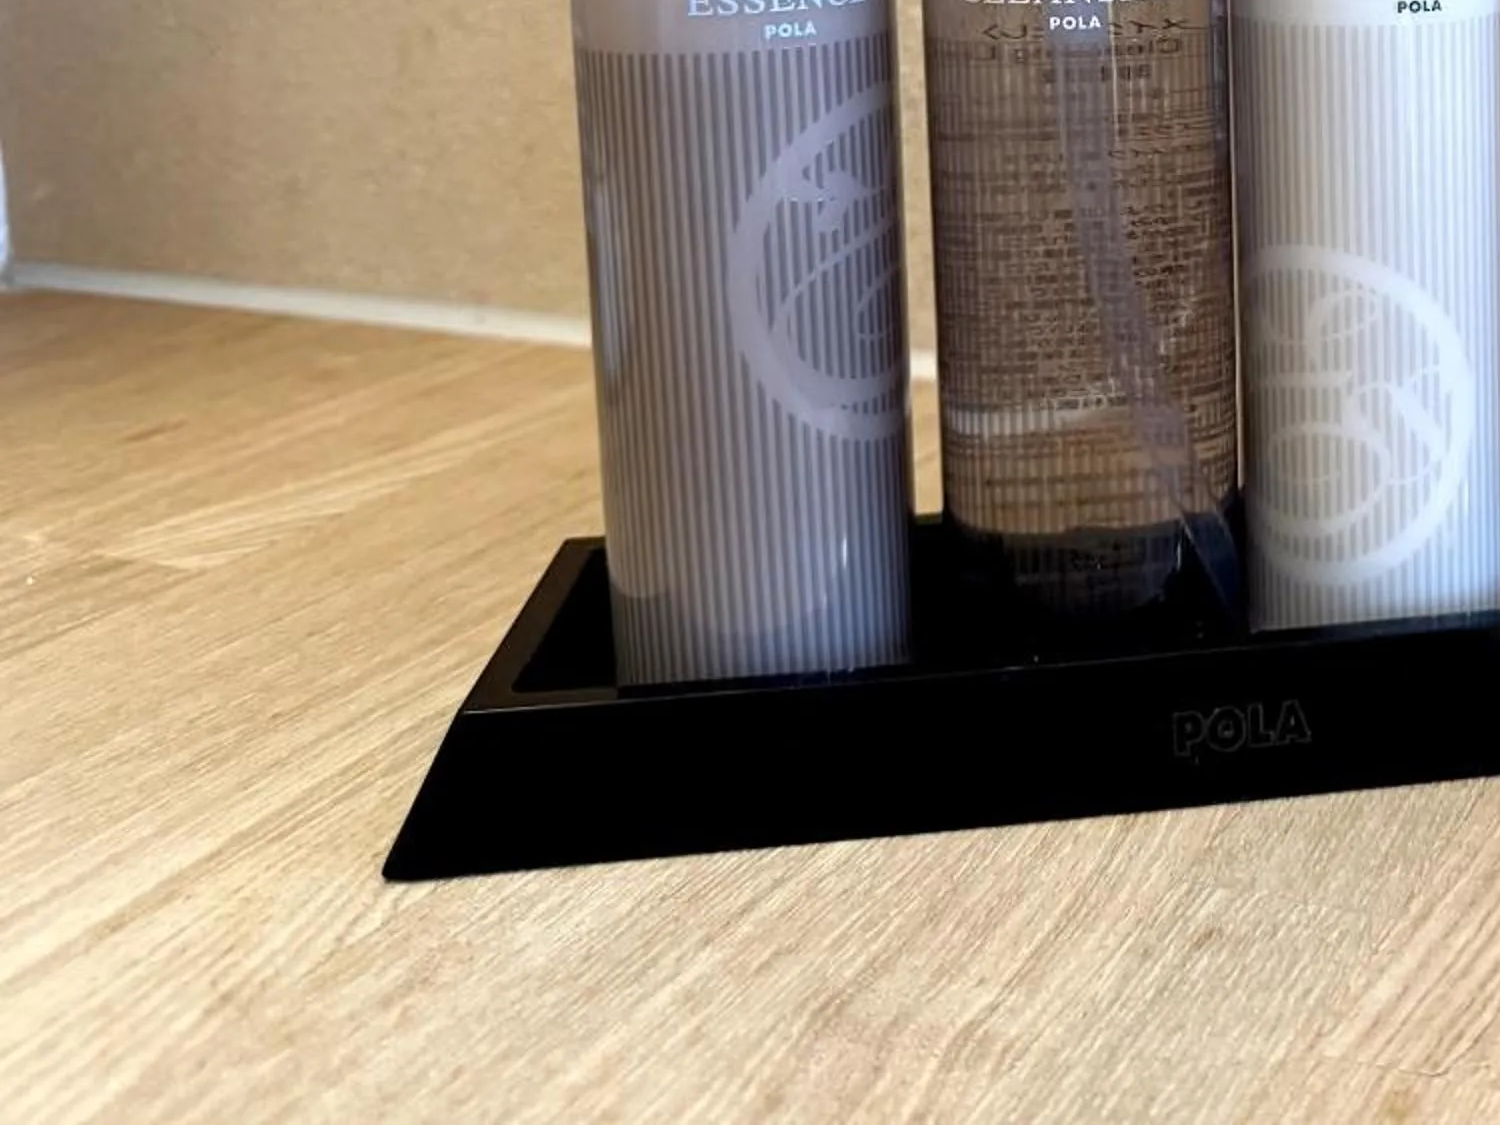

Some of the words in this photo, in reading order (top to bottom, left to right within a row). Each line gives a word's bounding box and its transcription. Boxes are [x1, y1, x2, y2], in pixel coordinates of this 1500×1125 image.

[1397, 0, 1443, 14] POLA
[765, 20, 817, 40] POLA
[1050, 16, 1101, 30] POLA
[1172, 699, 1312, 756] POLA
